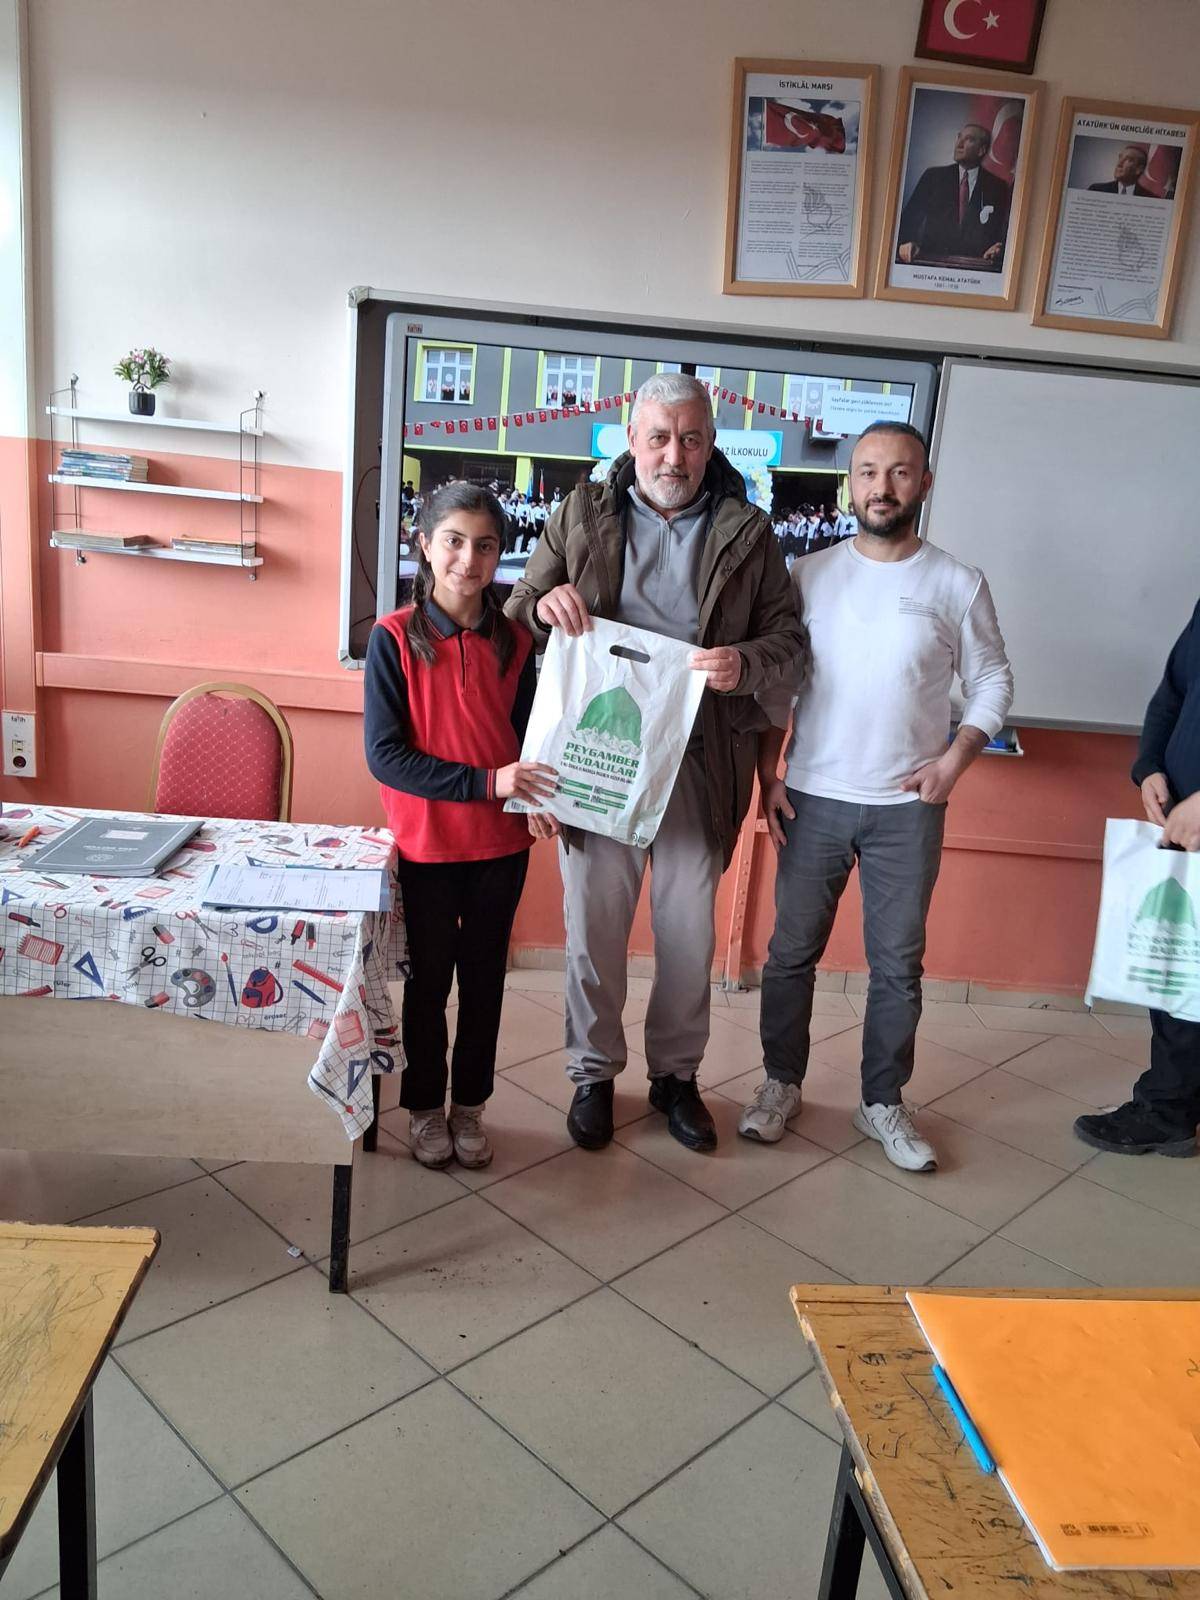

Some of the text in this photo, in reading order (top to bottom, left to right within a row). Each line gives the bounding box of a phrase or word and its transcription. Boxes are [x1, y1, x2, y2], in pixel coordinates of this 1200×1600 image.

[912, 273, 938, 281] MUSTAFA
[938, 275, 956, 283] KEMAL
[731, 446, 768, 457] İLKOKULU
[565, 742, 640, 769] PEYGAMBER
[562, 752, 638, 779] SEVDALILARI
